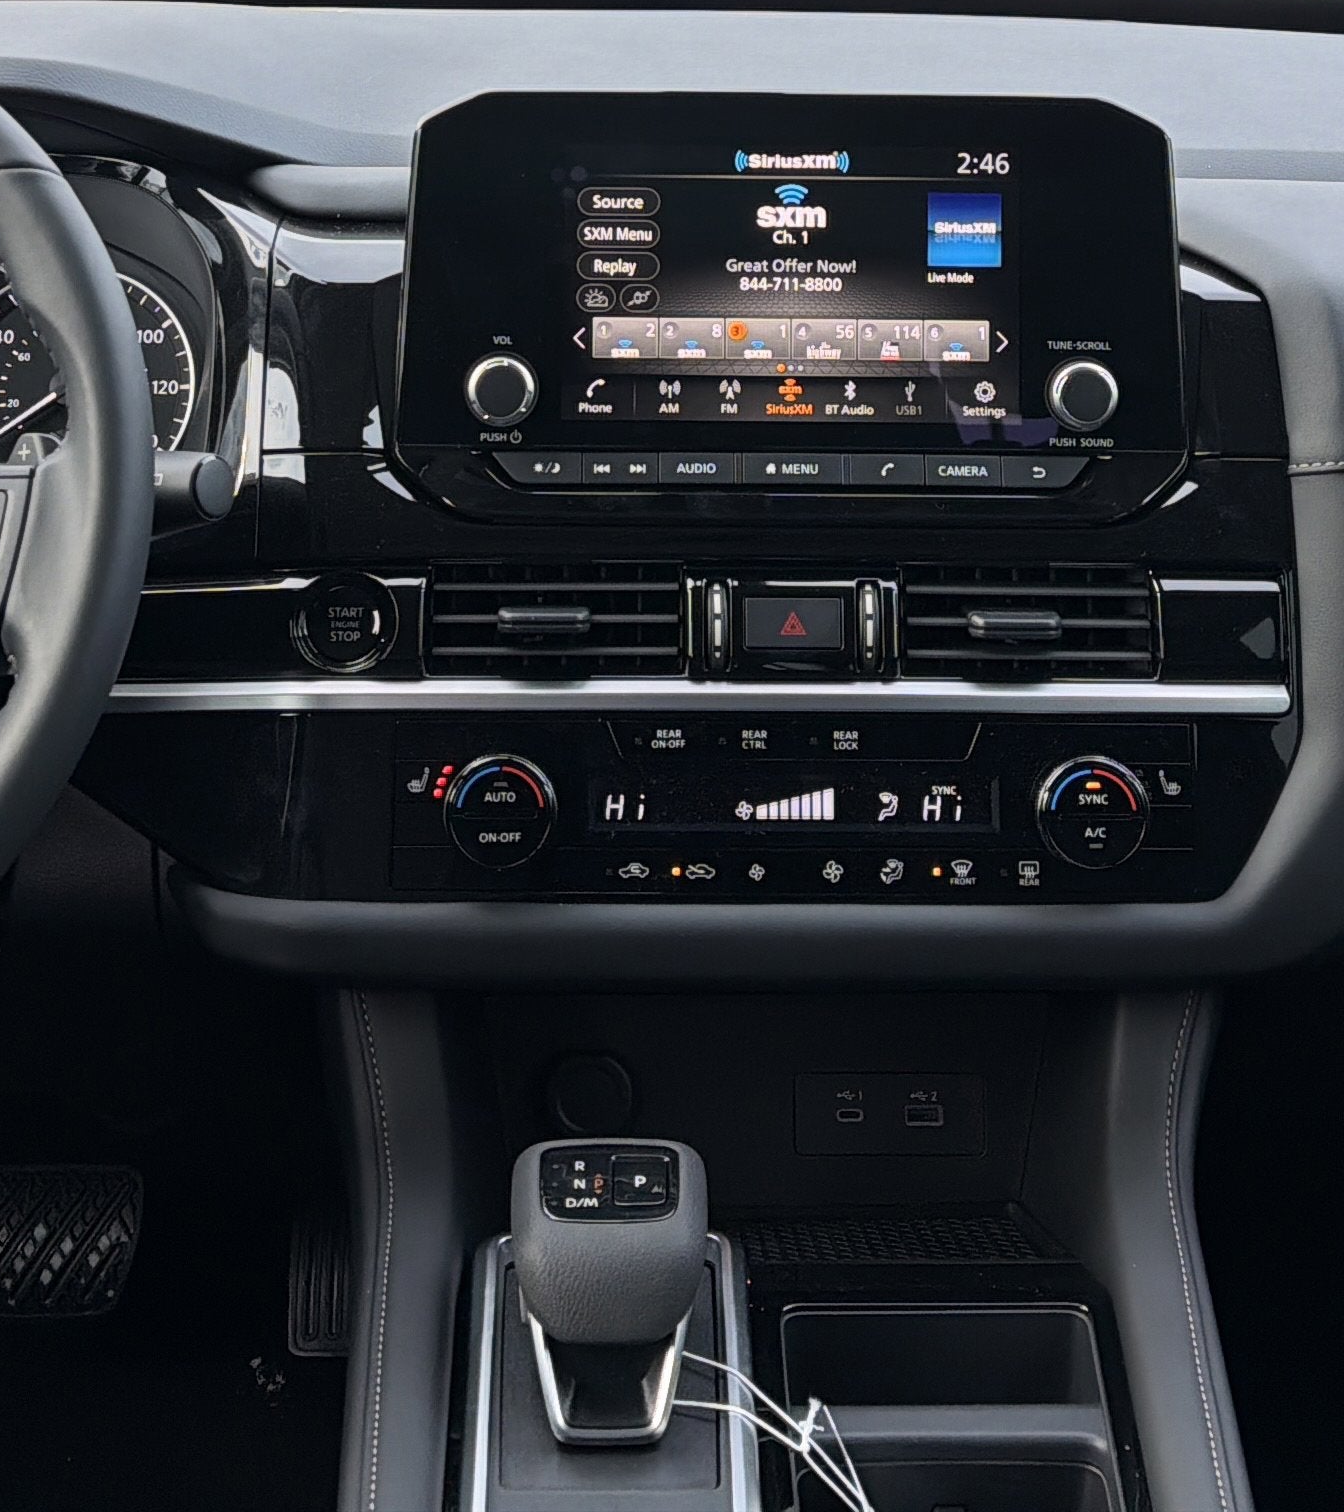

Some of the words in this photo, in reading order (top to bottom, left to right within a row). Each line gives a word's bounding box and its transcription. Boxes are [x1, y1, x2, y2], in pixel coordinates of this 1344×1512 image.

[956, 152, 1010, 175] 2:46
[592, 194, 644, 210] Source
[756, 206, 827, 228] sxm
[583, 227, 613, 242] SXM
[616, 227, 653, 242] Menu
[772, 230, 797, 245] Ch.
[801, 231, 809, 245] 1
[593, 258, 637, 276] Replay
[725, 258, 768, 273] Great
[772, 257, 813, 274] Offer
[817, 259, 857, 274] Now!
[927, 272, 946, 284] Live
[947, 272, 974, 284] Mode
[739, 277, 843, 292] 844-711-8800
[646, 323, 656, 338] 2
[711, 324, 723, 338] 8
[780, 324, 787, 338] 1
[835, 325, 854, 339] 56
[894, 325, 921, 339] 114
[979, 326, 985, 340] 1
[136, 329, 164, 345] 100
[492, 335, 513, 345] VOL
[151, 380, 179, 395] 120
[578, 402, 613, 414] Phone
[659, 403, 680, 414] AM
[720, 403, 738, 414] FM
[766, 403, 813, 415] SiriusXM
[825, 404, 838, 415] BT
[841, 404, 875, 416] Audio
[895, 405, 922, 416] USB1
[962, 406, 1006, 419] Settings
[480, 433, 507, 442] PUSH
[1049, 437, 1076, 447] PUSH
[1080, 438, 1114, 448] SOUND
[677, 463, 716, 474] AUDIO
[781, 463, 819, 475] MENU
[938, 465, 988, 477] CAMERA
[328, 607, 364, 618] START
[330, 620, 360, 628] ENGINE
[330, 631, 361, 642] STOP
[657, 729, 682, 739] REAR
[742, 730, 768, 739] REAR
[833, 731, 859, 740] REAR
[742, 740, 767, 750] CTRL
[833, 741, 859, 751] LOCK
[932, 785, 957, 796] SYNC
[484, 792, 516, 803] AUTO
[1078, 794, 1109, 806] SYNC
[605, 794, 646, 821] Hi
[922, 795, 962, 821] Hi
[1085, 827, 1107, 838] A/C
[950, 877, 977, 886] FRONT
[1019, 878, 1040, 887] REAR
[574, 1160, 585, 1171] R
[573, 1178, 586, 1190] N
[634, 1175, 647, 1188] P
[565, 1197, 599, 1208] D/M
